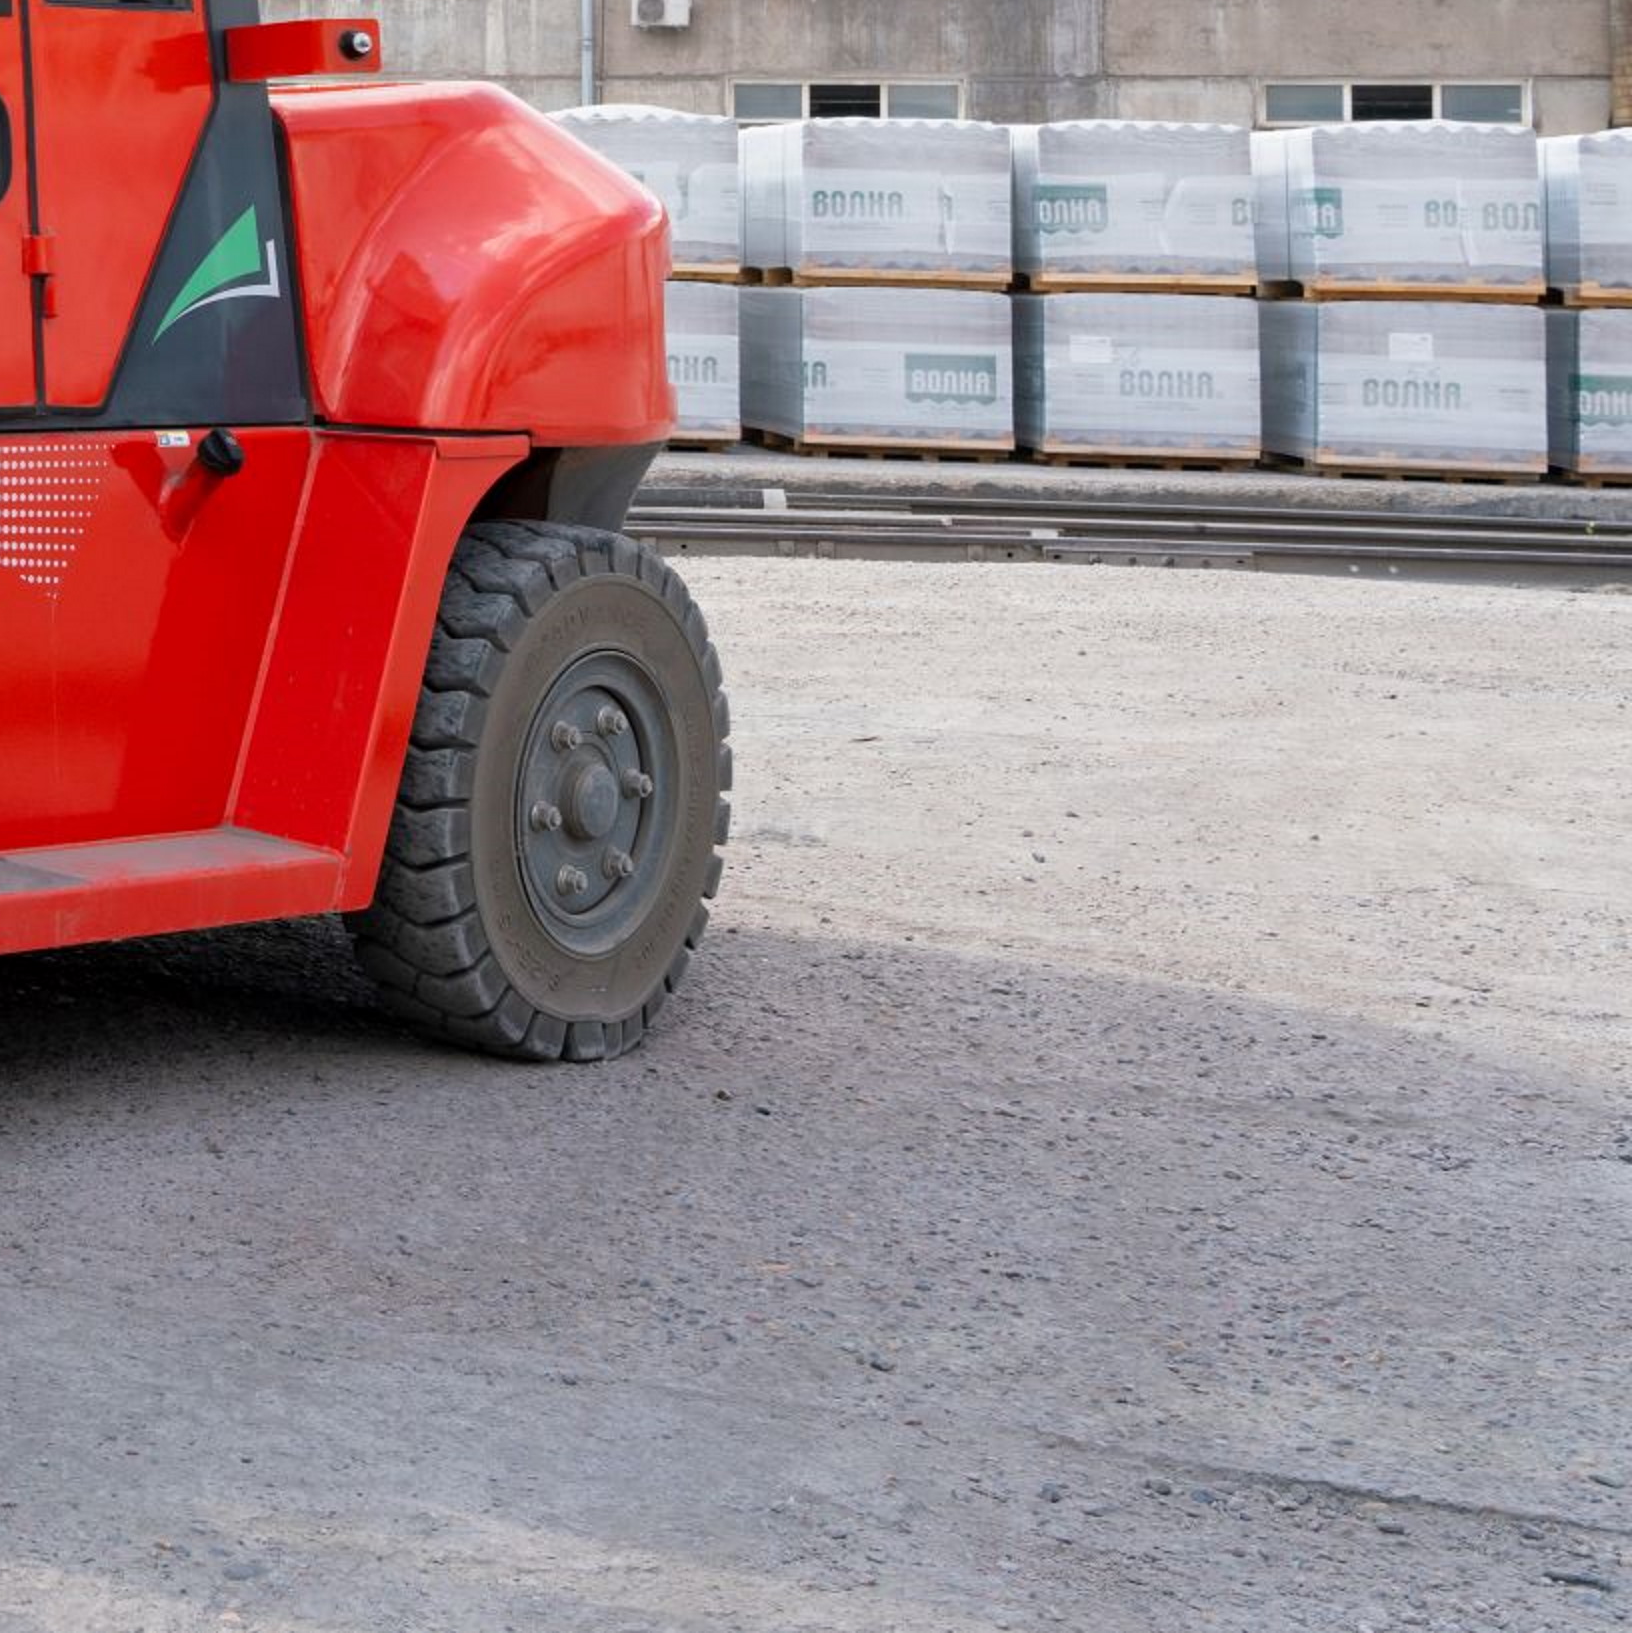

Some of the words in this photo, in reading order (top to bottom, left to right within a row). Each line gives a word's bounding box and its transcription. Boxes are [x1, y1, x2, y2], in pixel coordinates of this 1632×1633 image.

[812, 189, 904, 219] ВОЛНА
[910, 368, 992, 395] ВОЛНА
[1118, 368, 1214, 400] ВОЛНА
[1361, 377, 1462, 410] ВОЛНА
